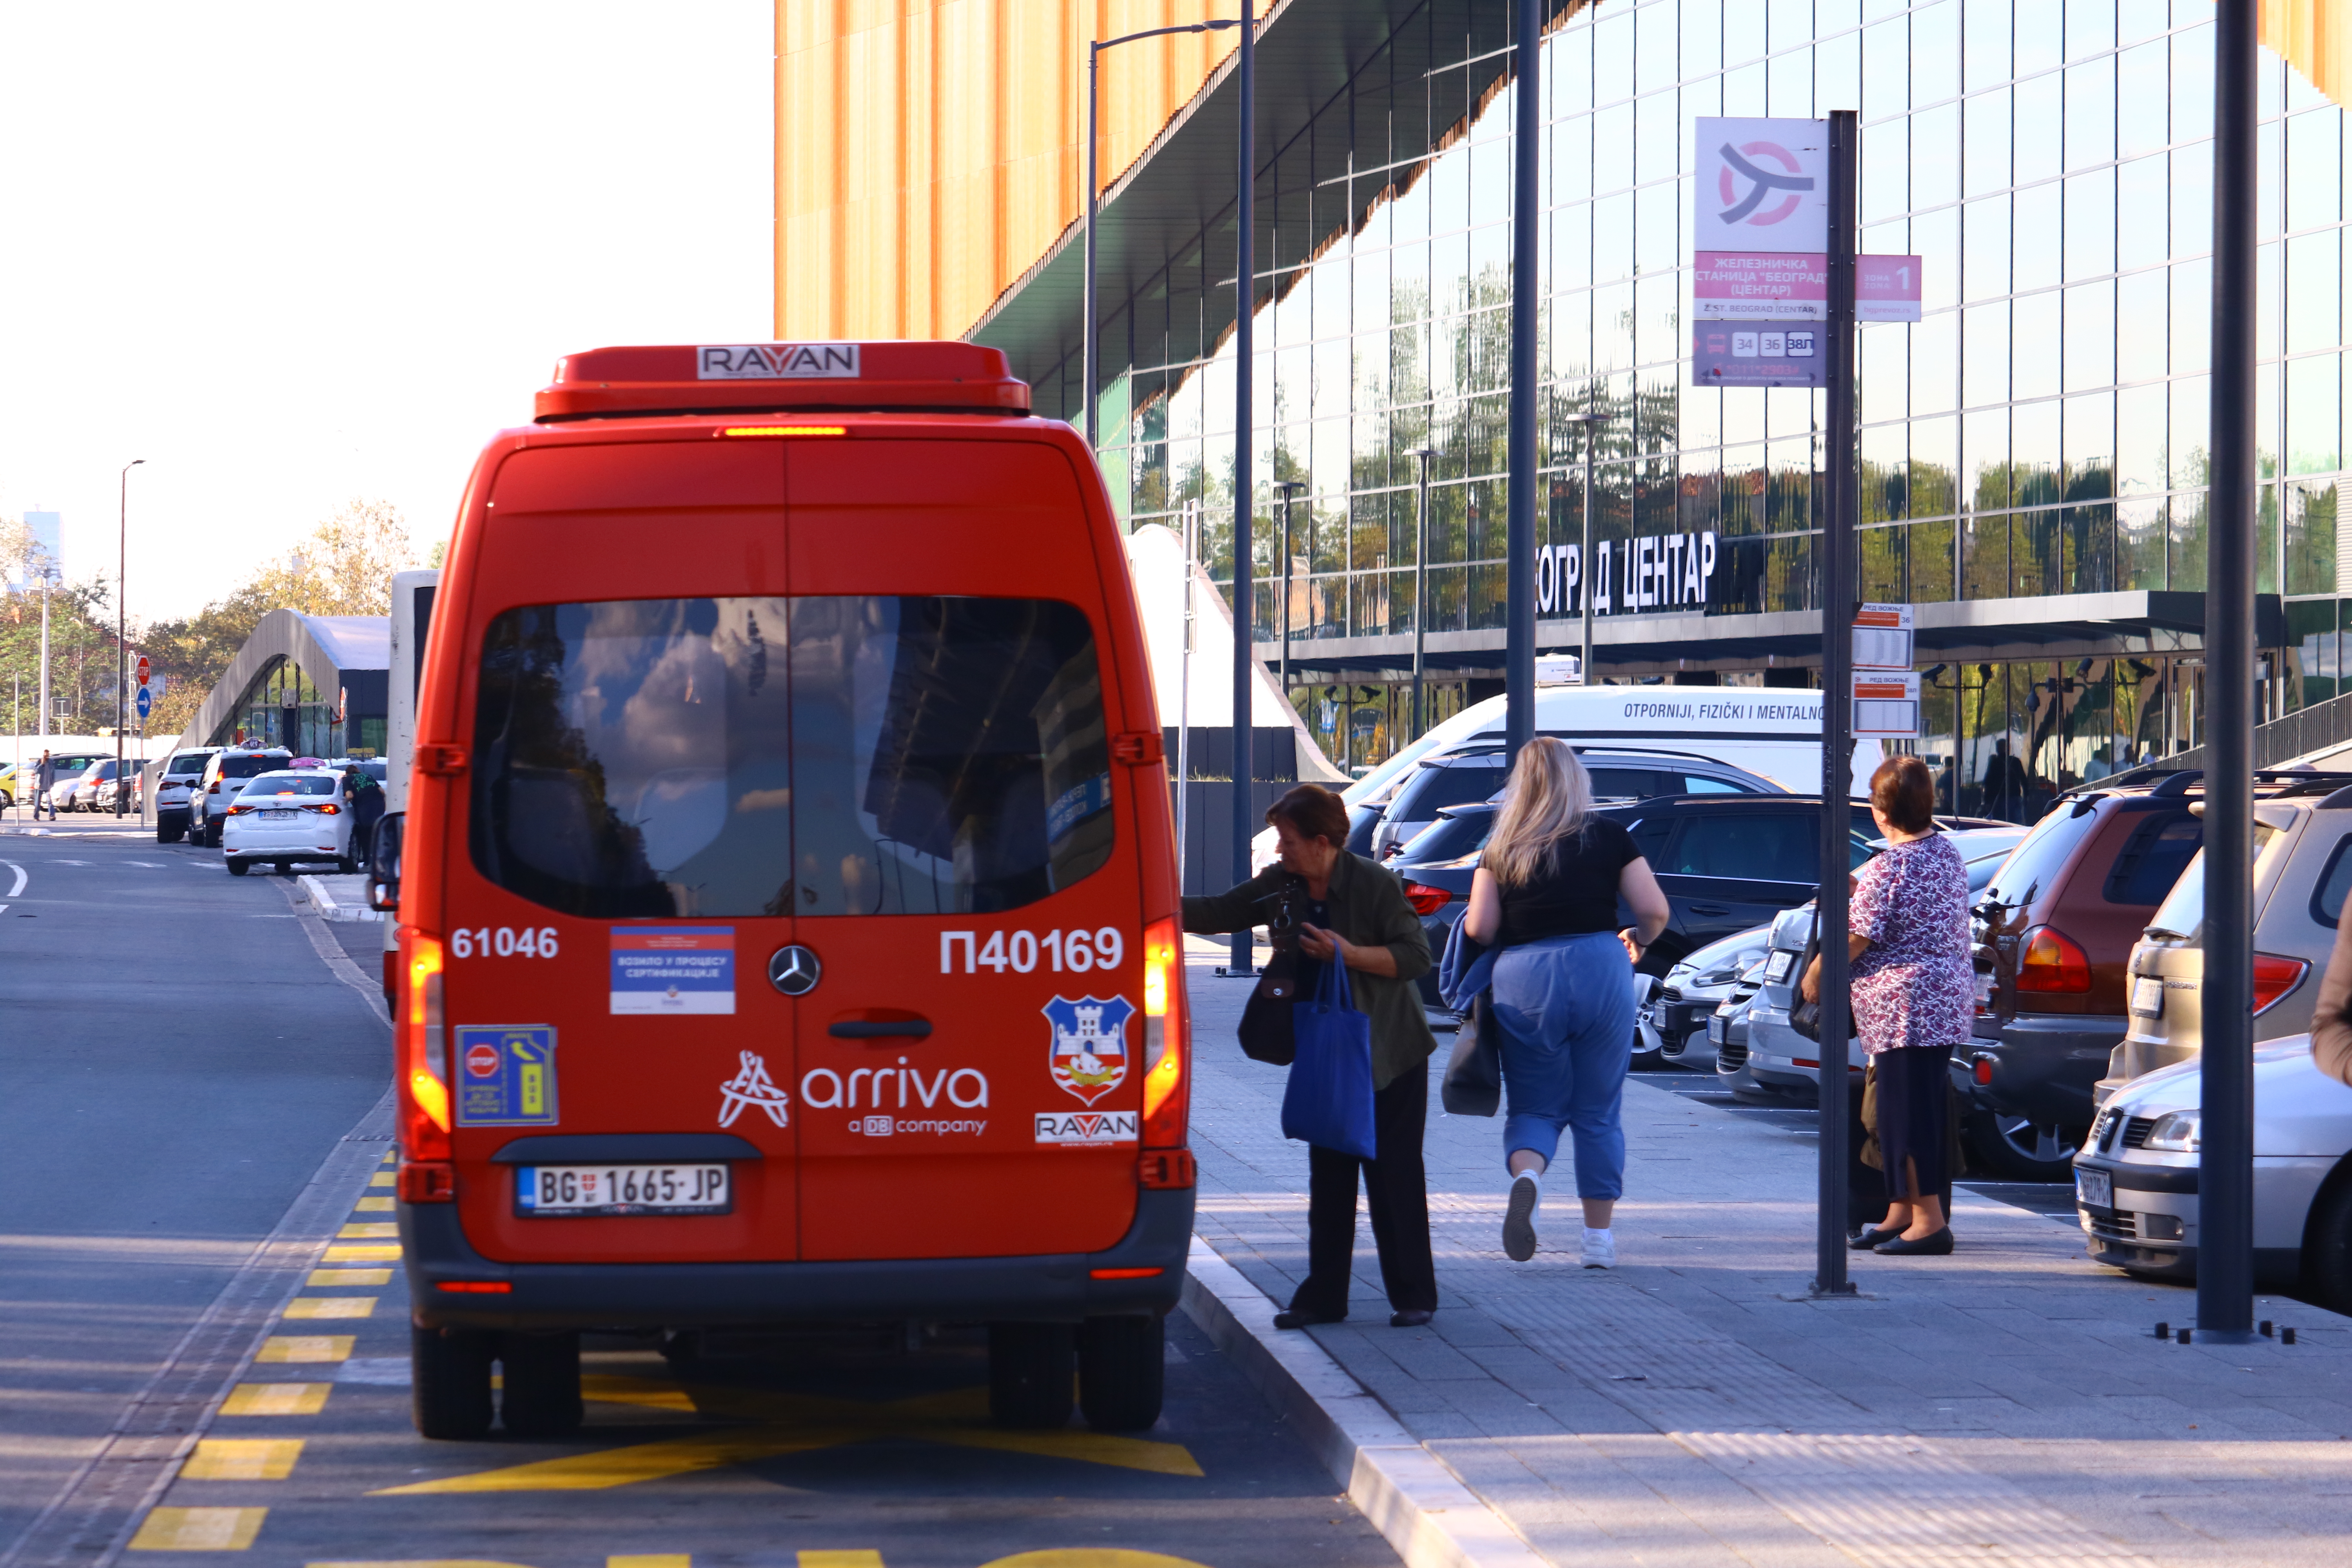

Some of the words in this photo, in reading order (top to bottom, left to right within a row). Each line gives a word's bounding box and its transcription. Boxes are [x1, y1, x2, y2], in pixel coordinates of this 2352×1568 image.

[1715, 258, 1808, 269] ЖЕЛЕЗНИЧКА
[1695, 271, 1757, 283] СТАНИЦА
[1896, 266, 1909, 290] 1
[1731, 285, 1791, 296] (ЦЕНТАР)
[1775, 306, 1817, 314] (CENTAR)
[1737, 339, 1752, 349] 34
[1765, 339, 1780, 349] 36
[1788, 339, 1814, 349] 38Л
[703, 346, 852, 372] RAYAN
[1535, 540, 1610, 615] ОГРД
[1623, 532, 1716, 613] ЦЕНТАР
[138, 666, 149, 676] STOP
[1624, 703, 1695, 721] OTPORNIJI,
[1699, 701, 1744, 719] FIZIČKI
[1749, 705, 1752, 719] I
[452, 926, 559, 958] 61046
[940, 926, 1123, 974] П40169
[617, 956, 663, 966] ВОЗИЛО
[665, 957, 673, 966] У
[675, 956, 727, 967] ПРОЦЕСУ
[625, 969, 720, 978] СЕРТИФИКАЦИЈЕ
[469, 1056, 495, 1066] STOP
[800, 1056, 989, 1109] arriva
[848, 1120, 861, 1132] a
[867, 1118, 889, 1132] DB
[896, 1120, 987, 1136] company
[1035, 1116, 1135, 1136] RAYAN
[541, 1171, 577, 1203] BG
[605, 1169, 722, 1202] 1665-JP
